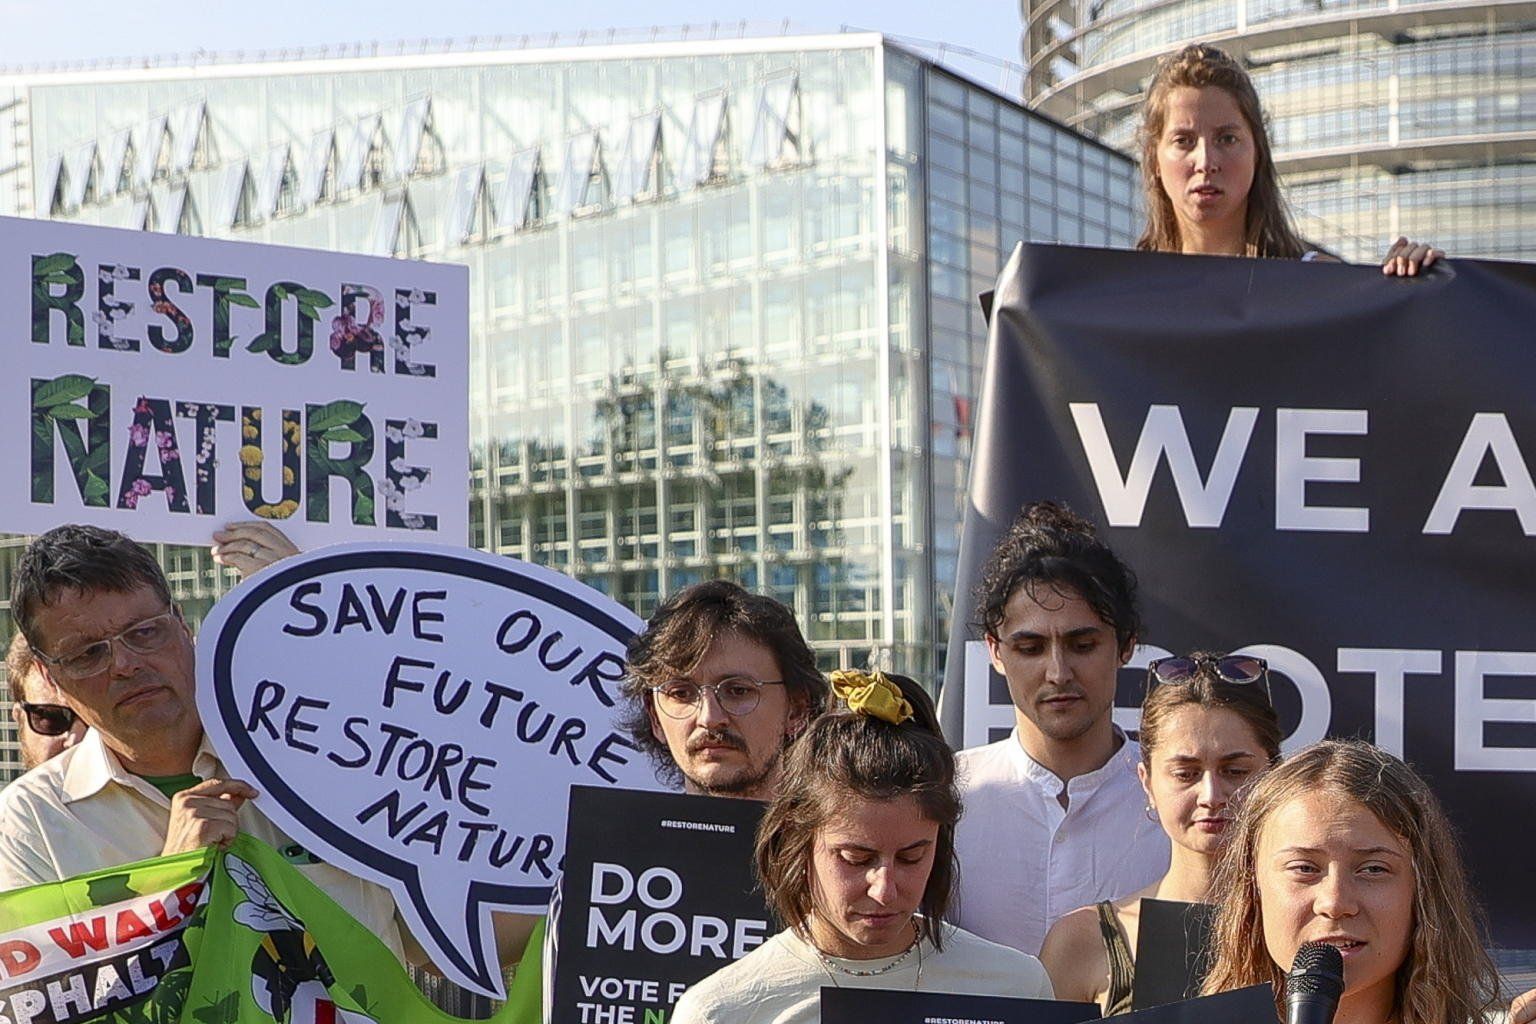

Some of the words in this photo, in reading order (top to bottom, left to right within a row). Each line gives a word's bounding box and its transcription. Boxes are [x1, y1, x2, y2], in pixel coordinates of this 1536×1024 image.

[31, 253, 437, 378] RESTORE
[30, 374, 438, 532] NATURE
[1069, 402, 1370, 532] WE
[283, 582, 447, 643] SAVE
[495, 609, 627, 706] OUR
[247, 680, 499, 817] RESTORE
[383, 657, 635, 783] FUTURE
[355, 791, 566, 880] NATUR
[661, 820, 735, 833] #RESTORENATURE
[48, 882, 204, 959] WALD
[586, 907, 767, 959] MORE
[589, 862, 683, 909] DO
[579, 975, 659, 1003] VOTE
